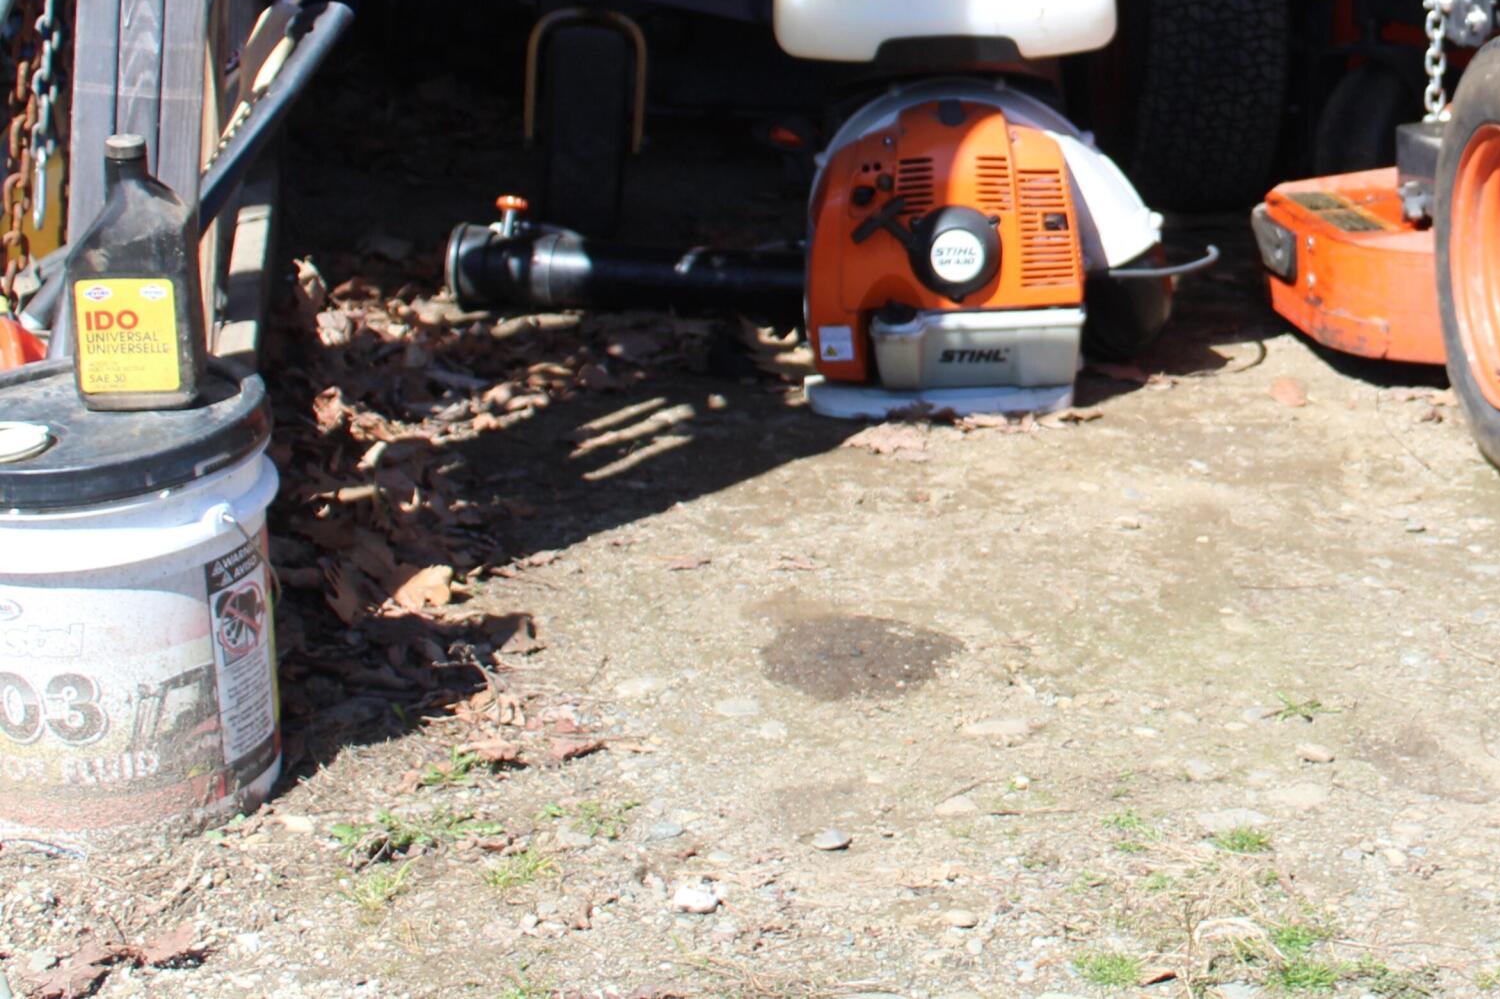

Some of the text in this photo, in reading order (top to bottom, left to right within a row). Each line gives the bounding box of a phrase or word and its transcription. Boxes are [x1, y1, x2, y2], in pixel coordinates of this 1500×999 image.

[935, 246, 977, 257] STIHL
[85, 309, 139, 331] IDO
[86, 331, 158, 343] UNIVERSAL
[87, 343, 170, 354] UNIVERSELLE
[939, 349, 1007, 363] STIHL
[89, 374, 110, 383] SAE
